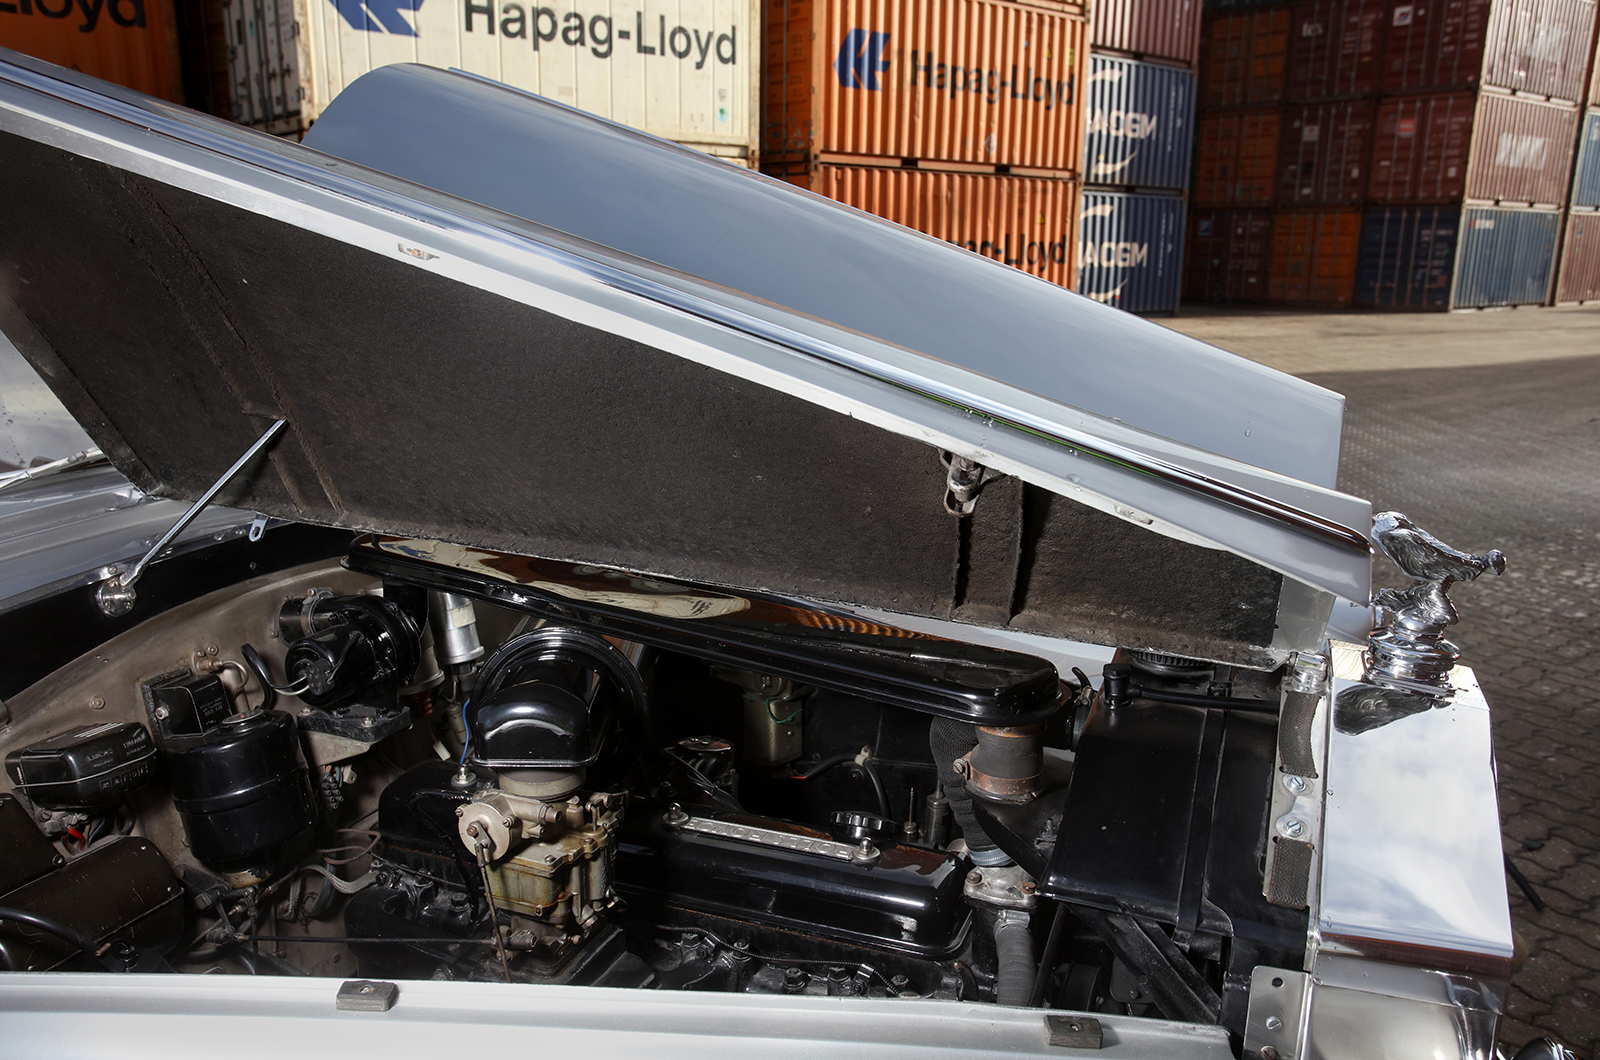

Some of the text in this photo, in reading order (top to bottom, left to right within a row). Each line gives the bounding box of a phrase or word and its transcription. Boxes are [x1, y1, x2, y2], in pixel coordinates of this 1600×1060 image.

[0, 0, 146, 33] oyd
[464, 0, 737, 70] Hapag-Lloyd
[911, 50, 1075, 110] Hapag-Lloyd
